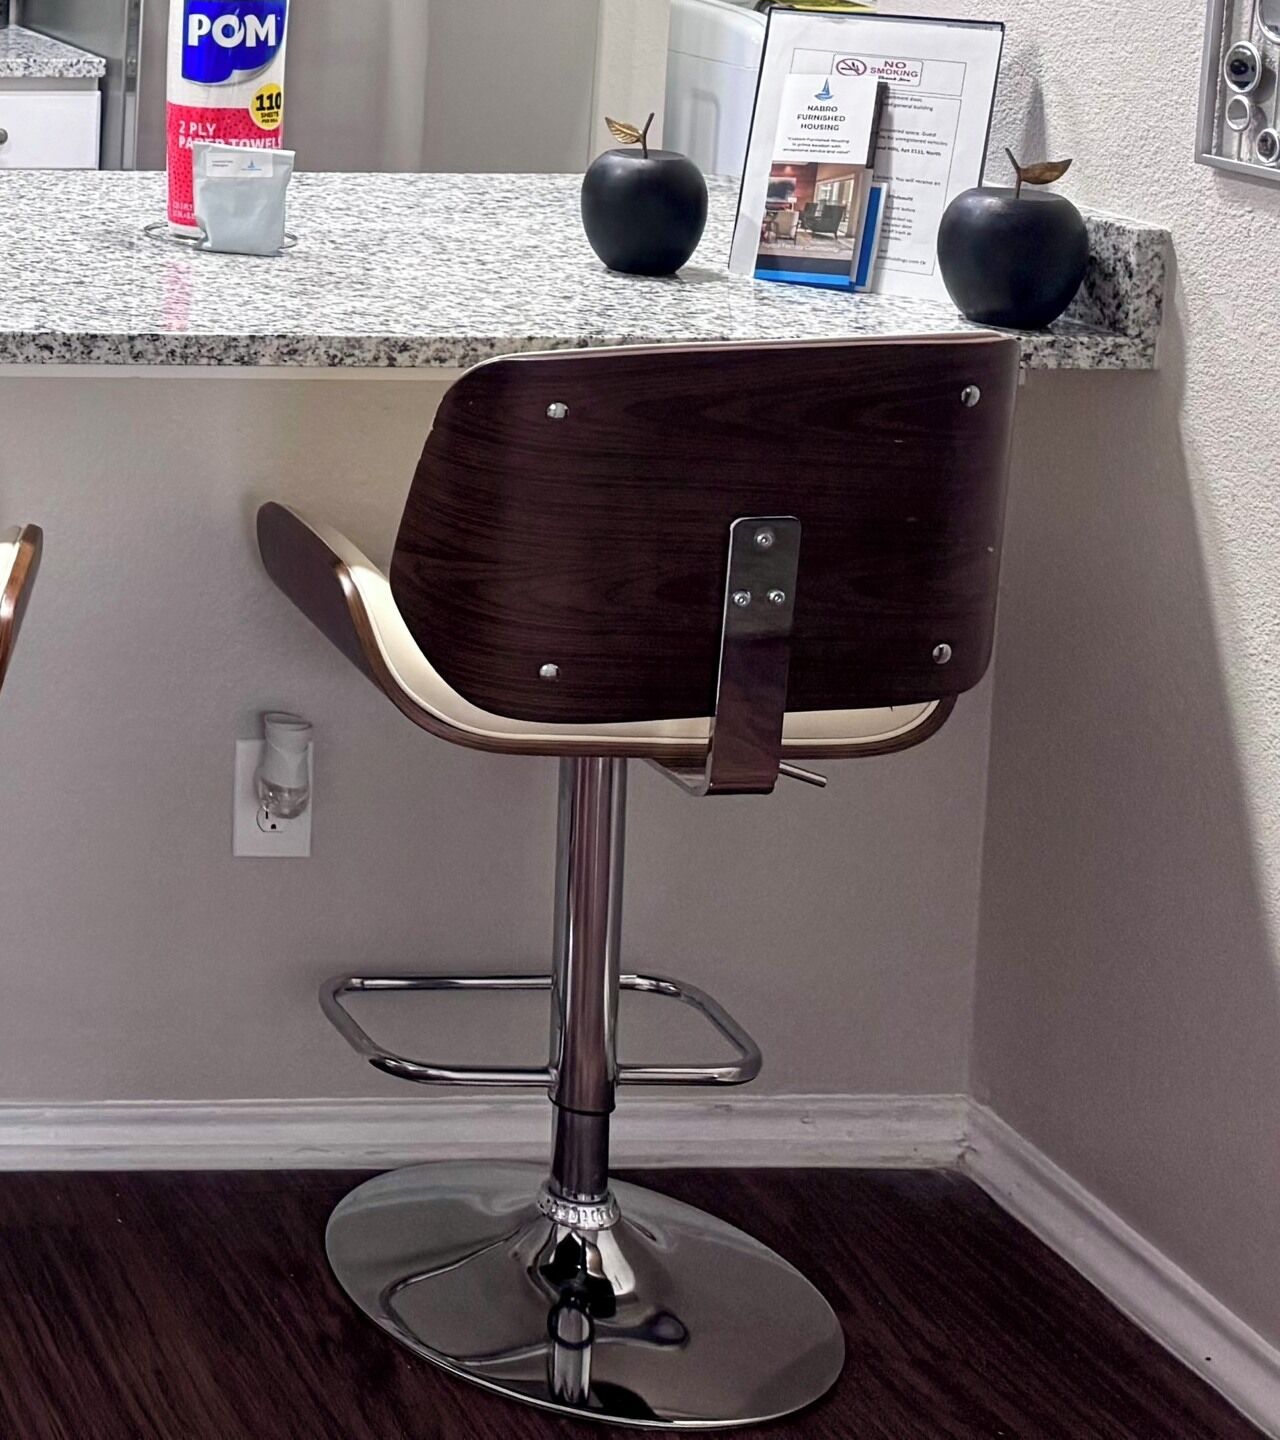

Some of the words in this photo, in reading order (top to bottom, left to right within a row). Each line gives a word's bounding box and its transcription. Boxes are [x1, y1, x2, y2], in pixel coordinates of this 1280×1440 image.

[187, 13, 276, 49] POM
[884, 60, 907, 69] NO
[870, 67, 919, 78] SMOKING
[256, 91, 282, 111] 110
[797, 114, 846, 122] FURNISHED
[178, 121, 186, 134] 2
[189, 122, 216, 136] PLY
[800, 123, 840, 131] HOUSING
